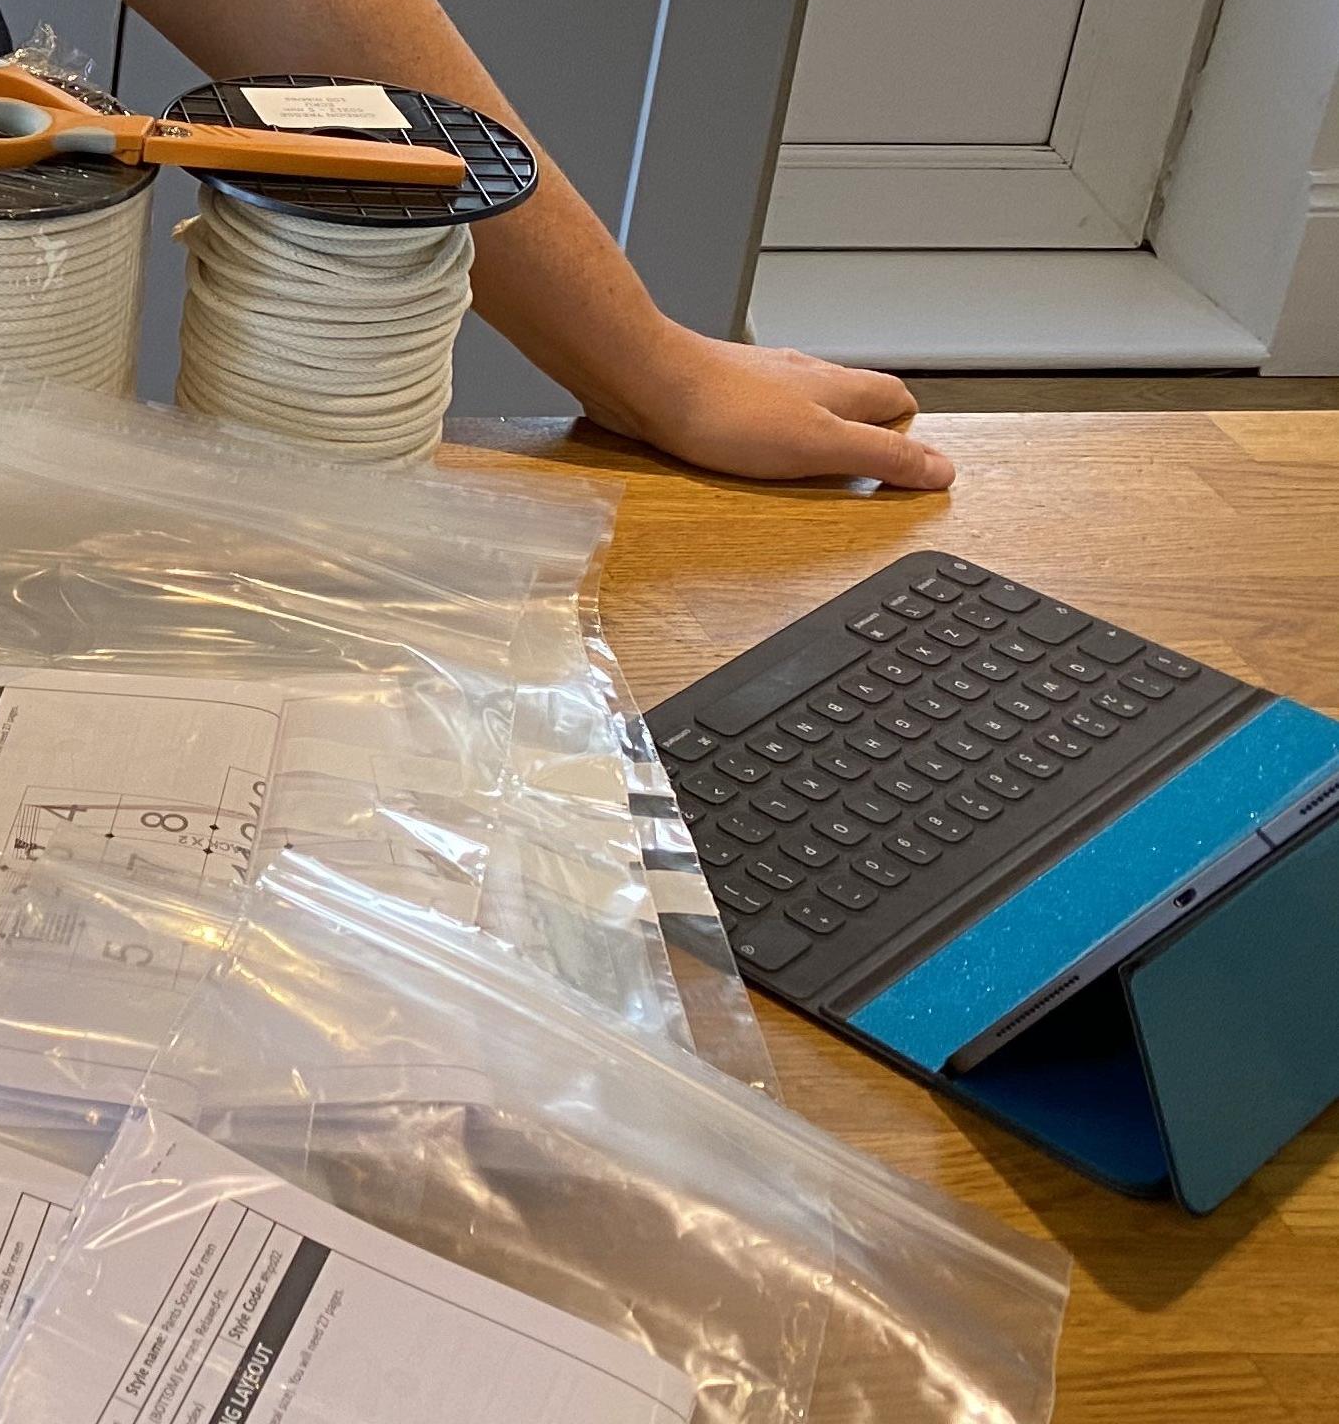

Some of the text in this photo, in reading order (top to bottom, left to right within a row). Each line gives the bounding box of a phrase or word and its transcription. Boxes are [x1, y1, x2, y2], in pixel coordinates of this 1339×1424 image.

[140, 812, 189, 833] 8
[2, 1262, 17, 1278] for
[11, 1240, 24, 1264] men
[125, 1243, 218, 1397] Style name: Pants Scrubs for men
[227, 1311, 251, 1340] Style
[243, 1281, 267, 1313] Code:
[174, 1358, 190, 1376] for
[235, 1343, 274, 1407] LAYEOUT
